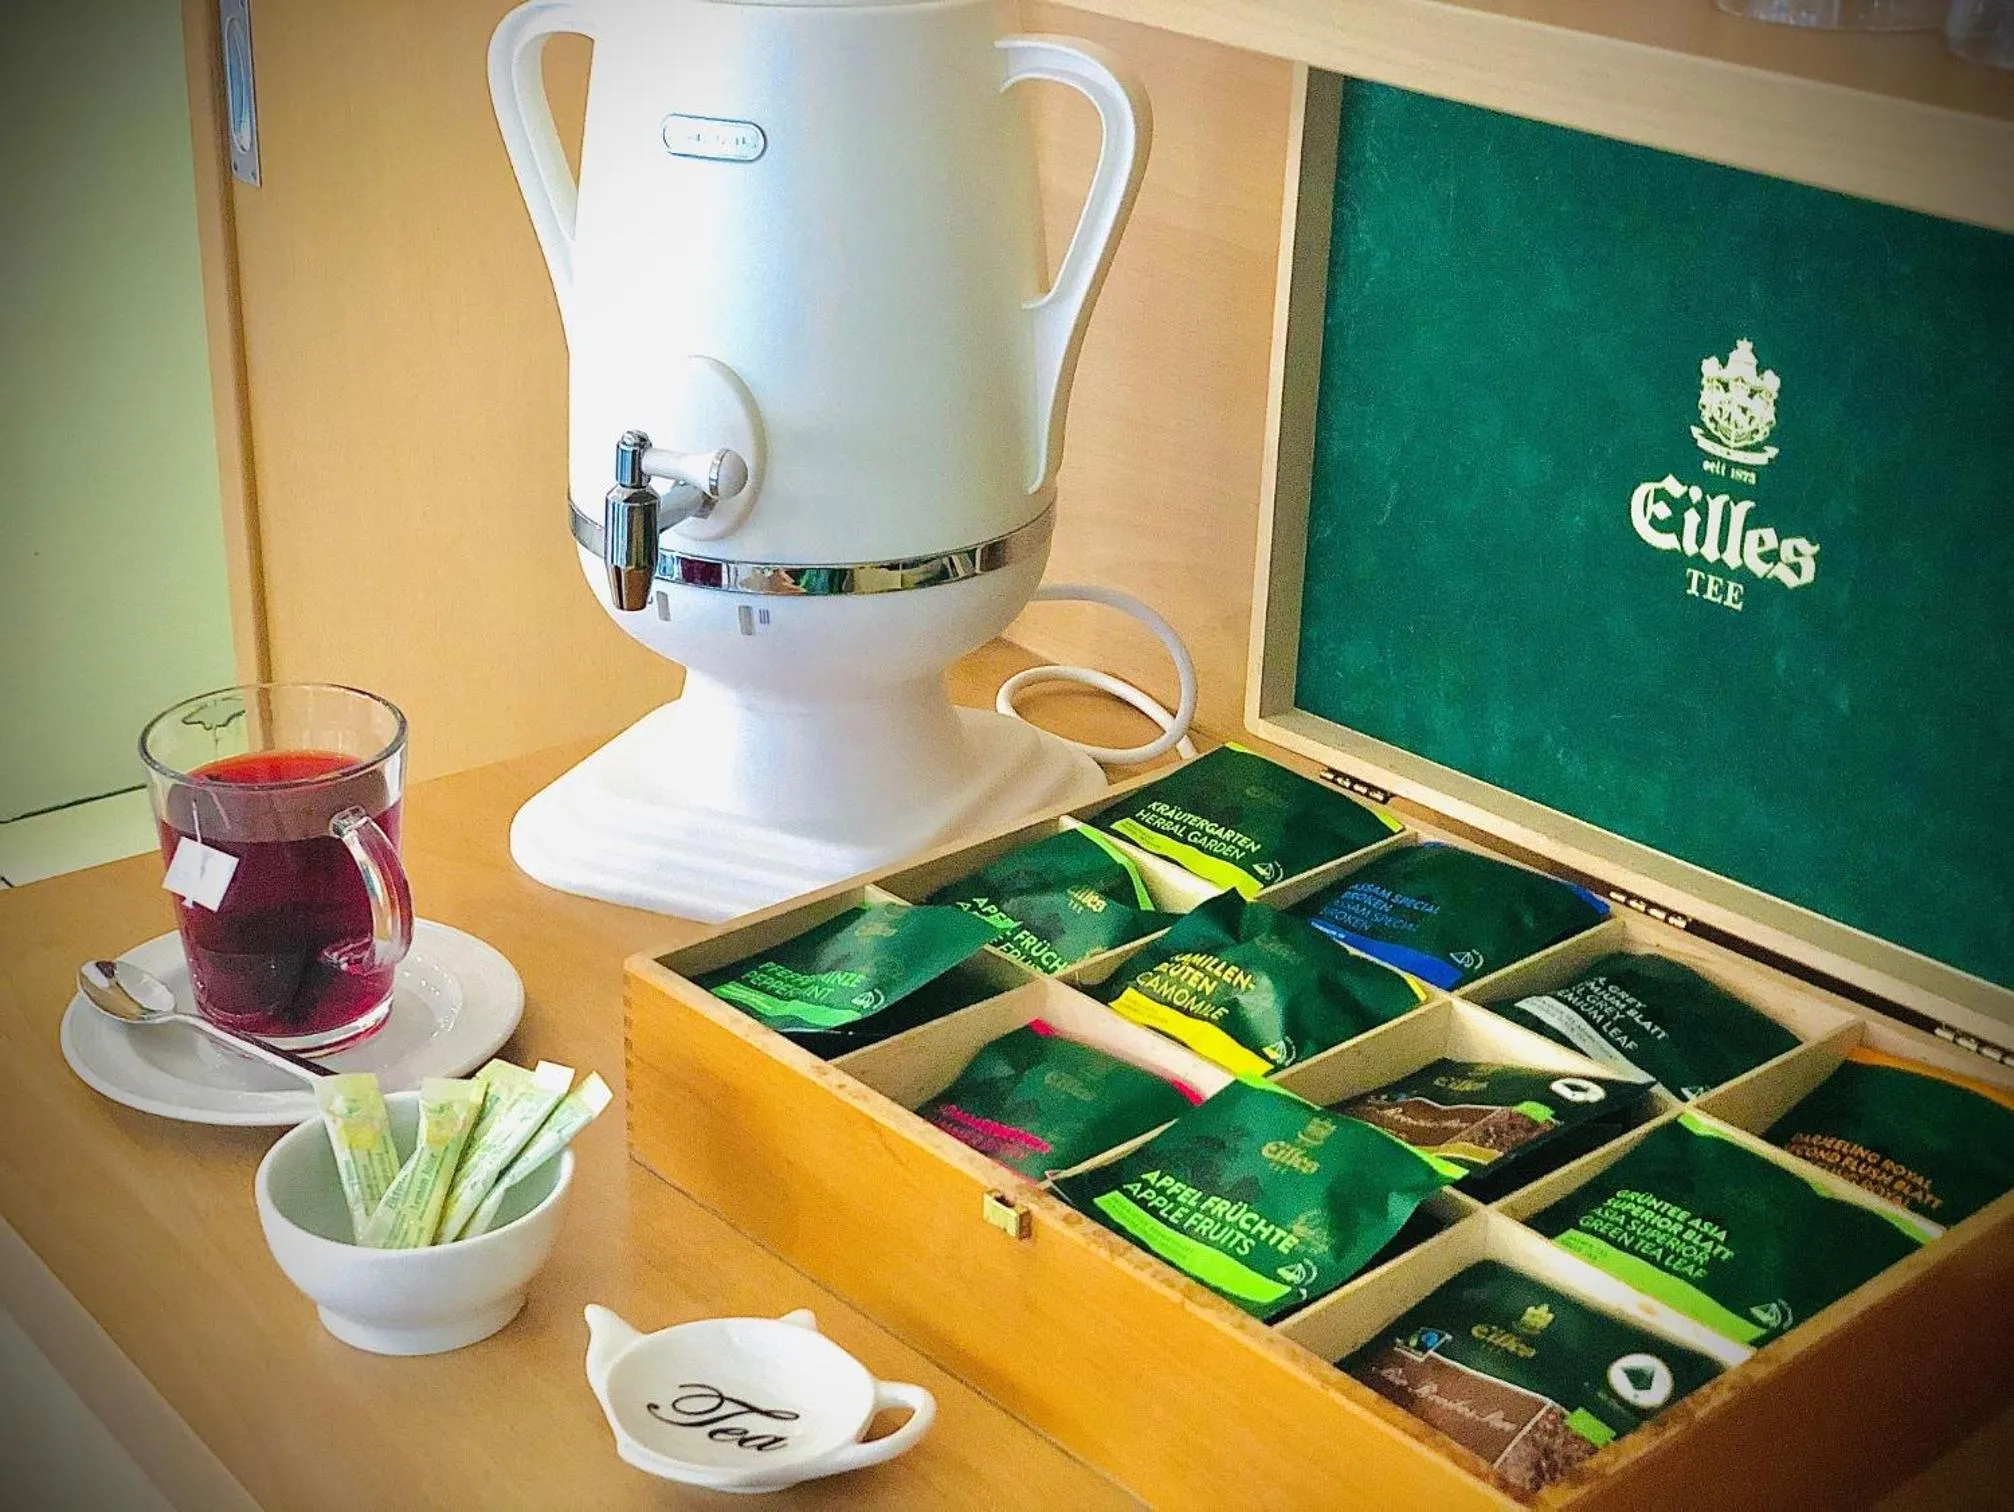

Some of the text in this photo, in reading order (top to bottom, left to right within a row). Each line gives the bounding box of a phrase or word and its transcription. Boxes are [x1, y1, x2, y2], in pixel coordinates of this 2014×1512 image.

[1631, 473, 1820, 589] Eilles
[1686, 567, 1744, 611] TEE
[1136, 809, 1184, 838] HERBAL
[1188, 830, 1245, 860] GARDEN
[1147, 801, 1261, 853] KRÄUTERGARTEN
[1136, 971, 1229, 1020] CAMOMILE
[1602, 1021, 1639, 1051] LEAF
[1123, 1182, 1188, 1224] APPLE
[1184, 1212, 1256, 1256] FRUITS
[1141, 1170, 1202, 1207] APFEL
[1201, 1201, 1299, 1254] FRÜCHTE
[1603, 1198, 1736, 1261] SUPERIOR BLATT
[1688, 1217, 1728, 1243] ASIA
[1579, 1215, 1635, 1249] GREEN
[1633, 1234, 1664, 1262] TEA
[1663, 1252, 1709, 1280] LEAF
[1626, 1219, 1711, 1265] SUPERIOR
[647, 1383, 800, 1452] Tea
